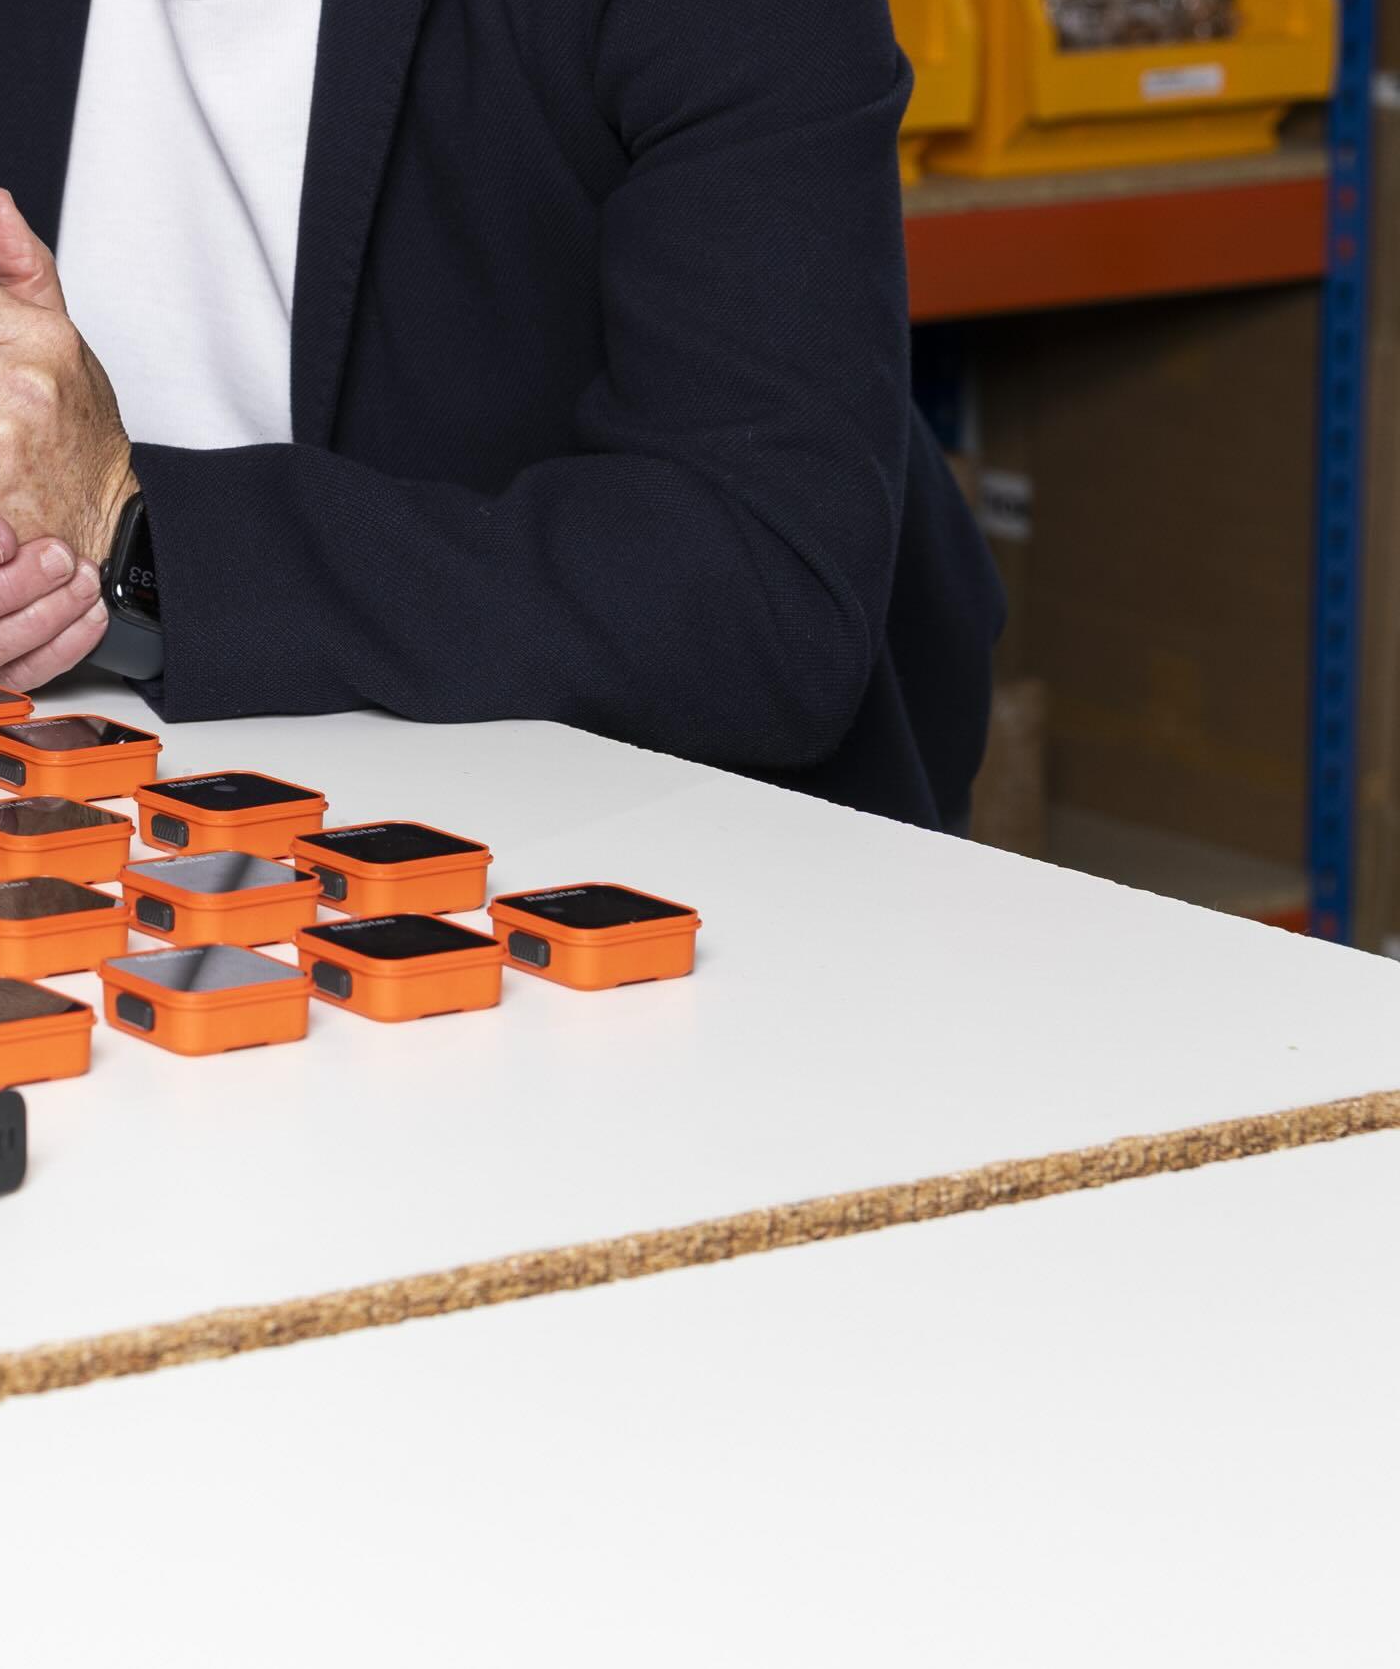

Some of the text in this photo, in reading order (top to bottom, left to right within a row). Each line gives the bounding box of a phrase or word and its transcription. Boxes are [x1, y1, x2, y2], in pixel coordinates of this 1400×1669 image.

[11, 719, 70, 730] Reactec
[167, 776, 226, 788] Reactec
[326, 826, 387, 839] Reactec
[525, 889, 587, 902] Reactec
